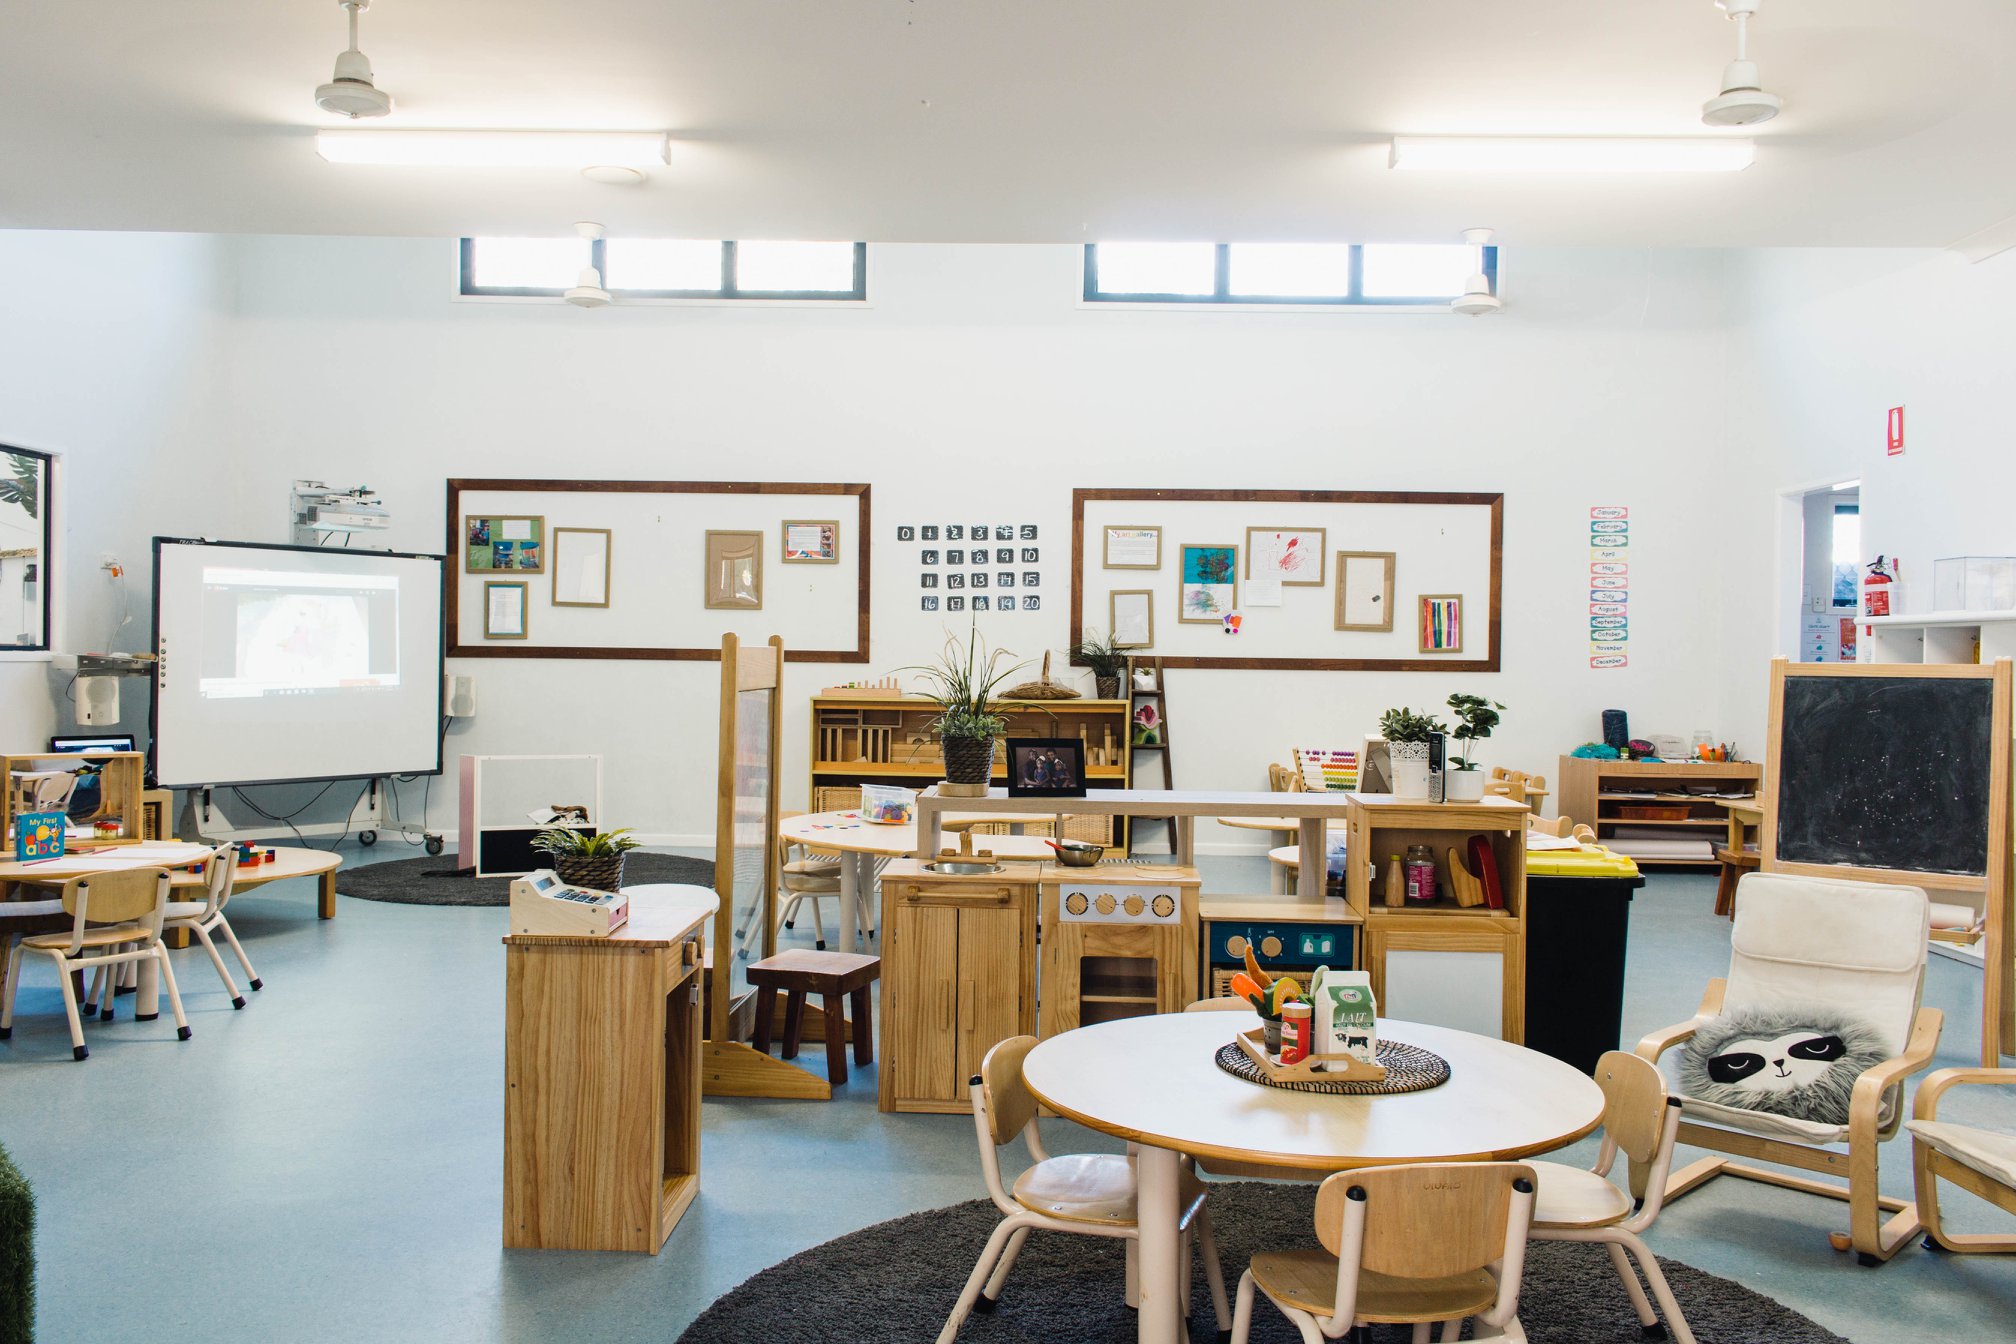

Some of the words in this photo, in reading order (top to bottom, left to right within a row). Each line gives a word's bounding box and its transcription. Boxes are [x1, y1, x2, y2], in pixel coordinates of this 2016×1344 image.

[901, 528, 910, 539] 0
[951, 527, 959, 539] 2
[976, 527, 984, 539] 3
[1024, 527, 1033, 538] 5
[926, 552, 934, 563] 6
[952, 552, 959, 563] 7
[976, 552, 984, 563] 8
[1001, 551, 1009, 562] 9
[1024, 550, 1036, 561] 10
[926, 576, 933, 586] 11
[950, 576, 962, 588] 12
[974, 575, 985, 586] 13
[1000, 574, 1012, 585] 14
[1025, 574, 1037, 585] 15
[924, 598, 936, 609] 16
[951, 598, 961, 609] 17
[975, 598, 986, 609] 18
[1000, 598, 1012, 609] 19
[1023, 597, 1039, 609] 20
[26, 841, 60, 855] abc
[1341, 1012, 1367, 1023] LAIT
